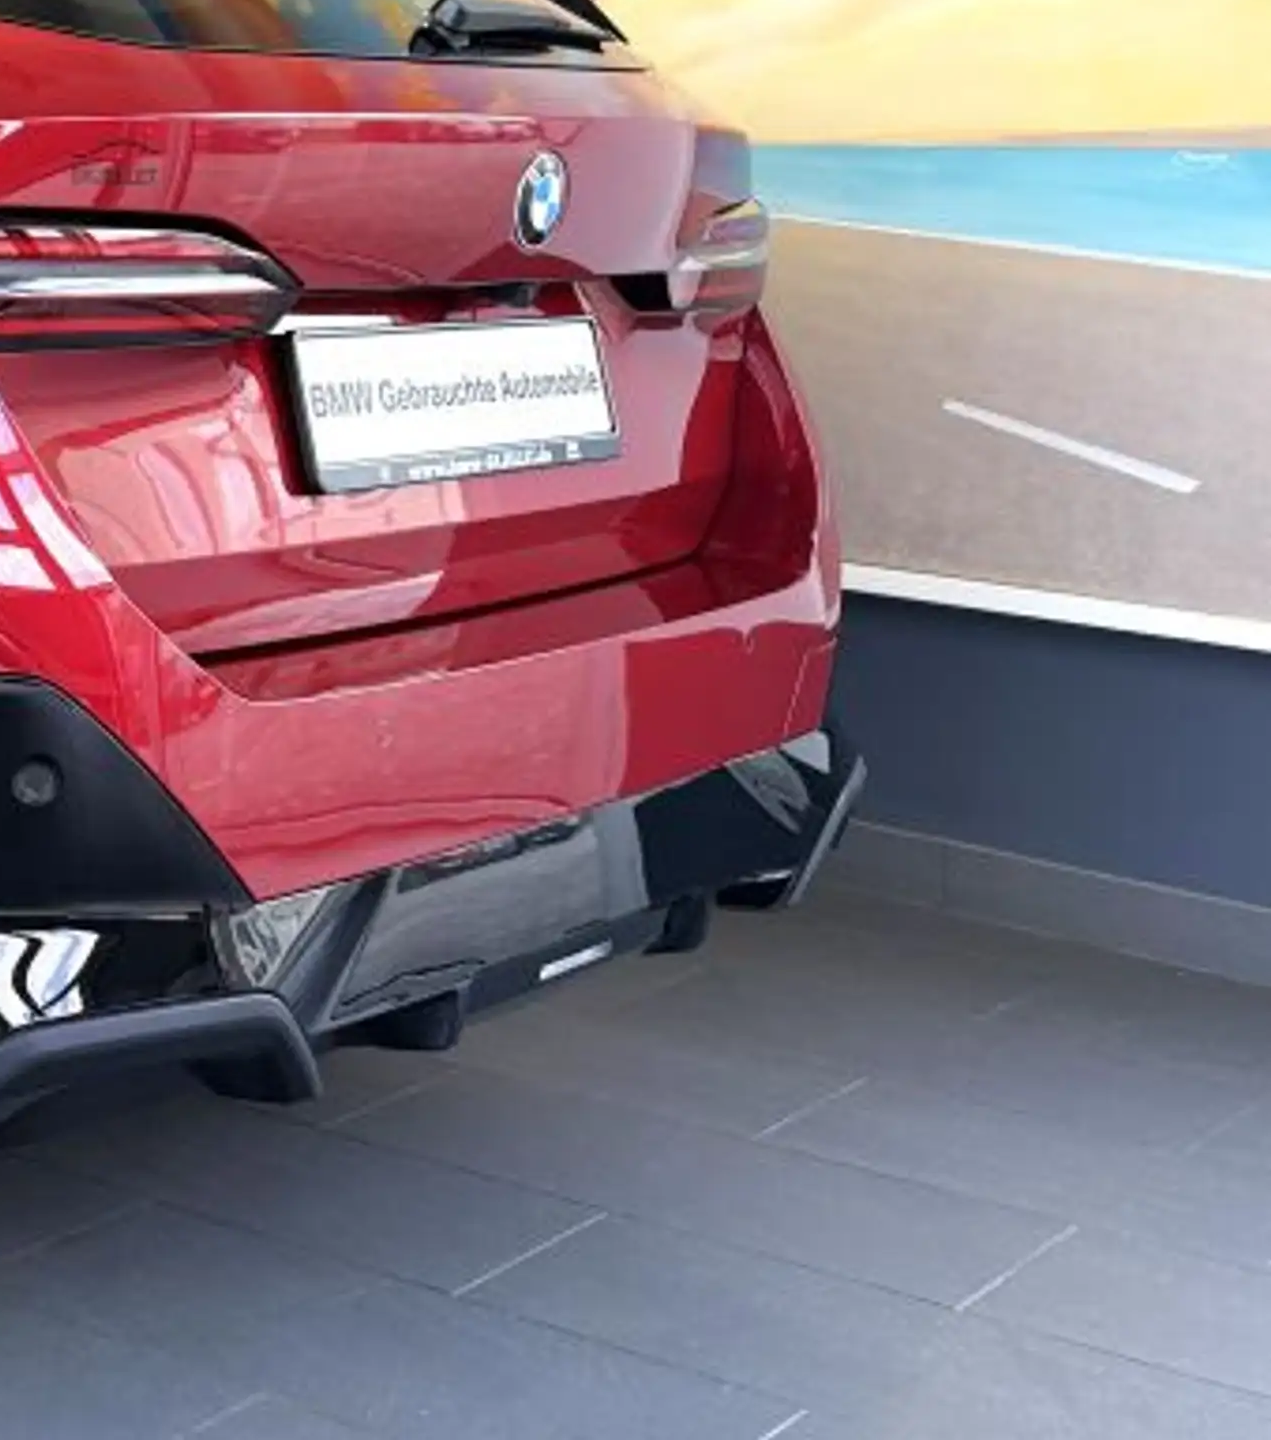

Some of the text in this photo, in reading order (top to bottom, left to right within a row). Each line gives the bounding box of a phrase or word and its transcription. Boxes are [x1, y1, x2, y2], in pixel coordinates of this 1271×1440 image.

[309, 364, 600, 418] BMW Gebrauchte Automobile
